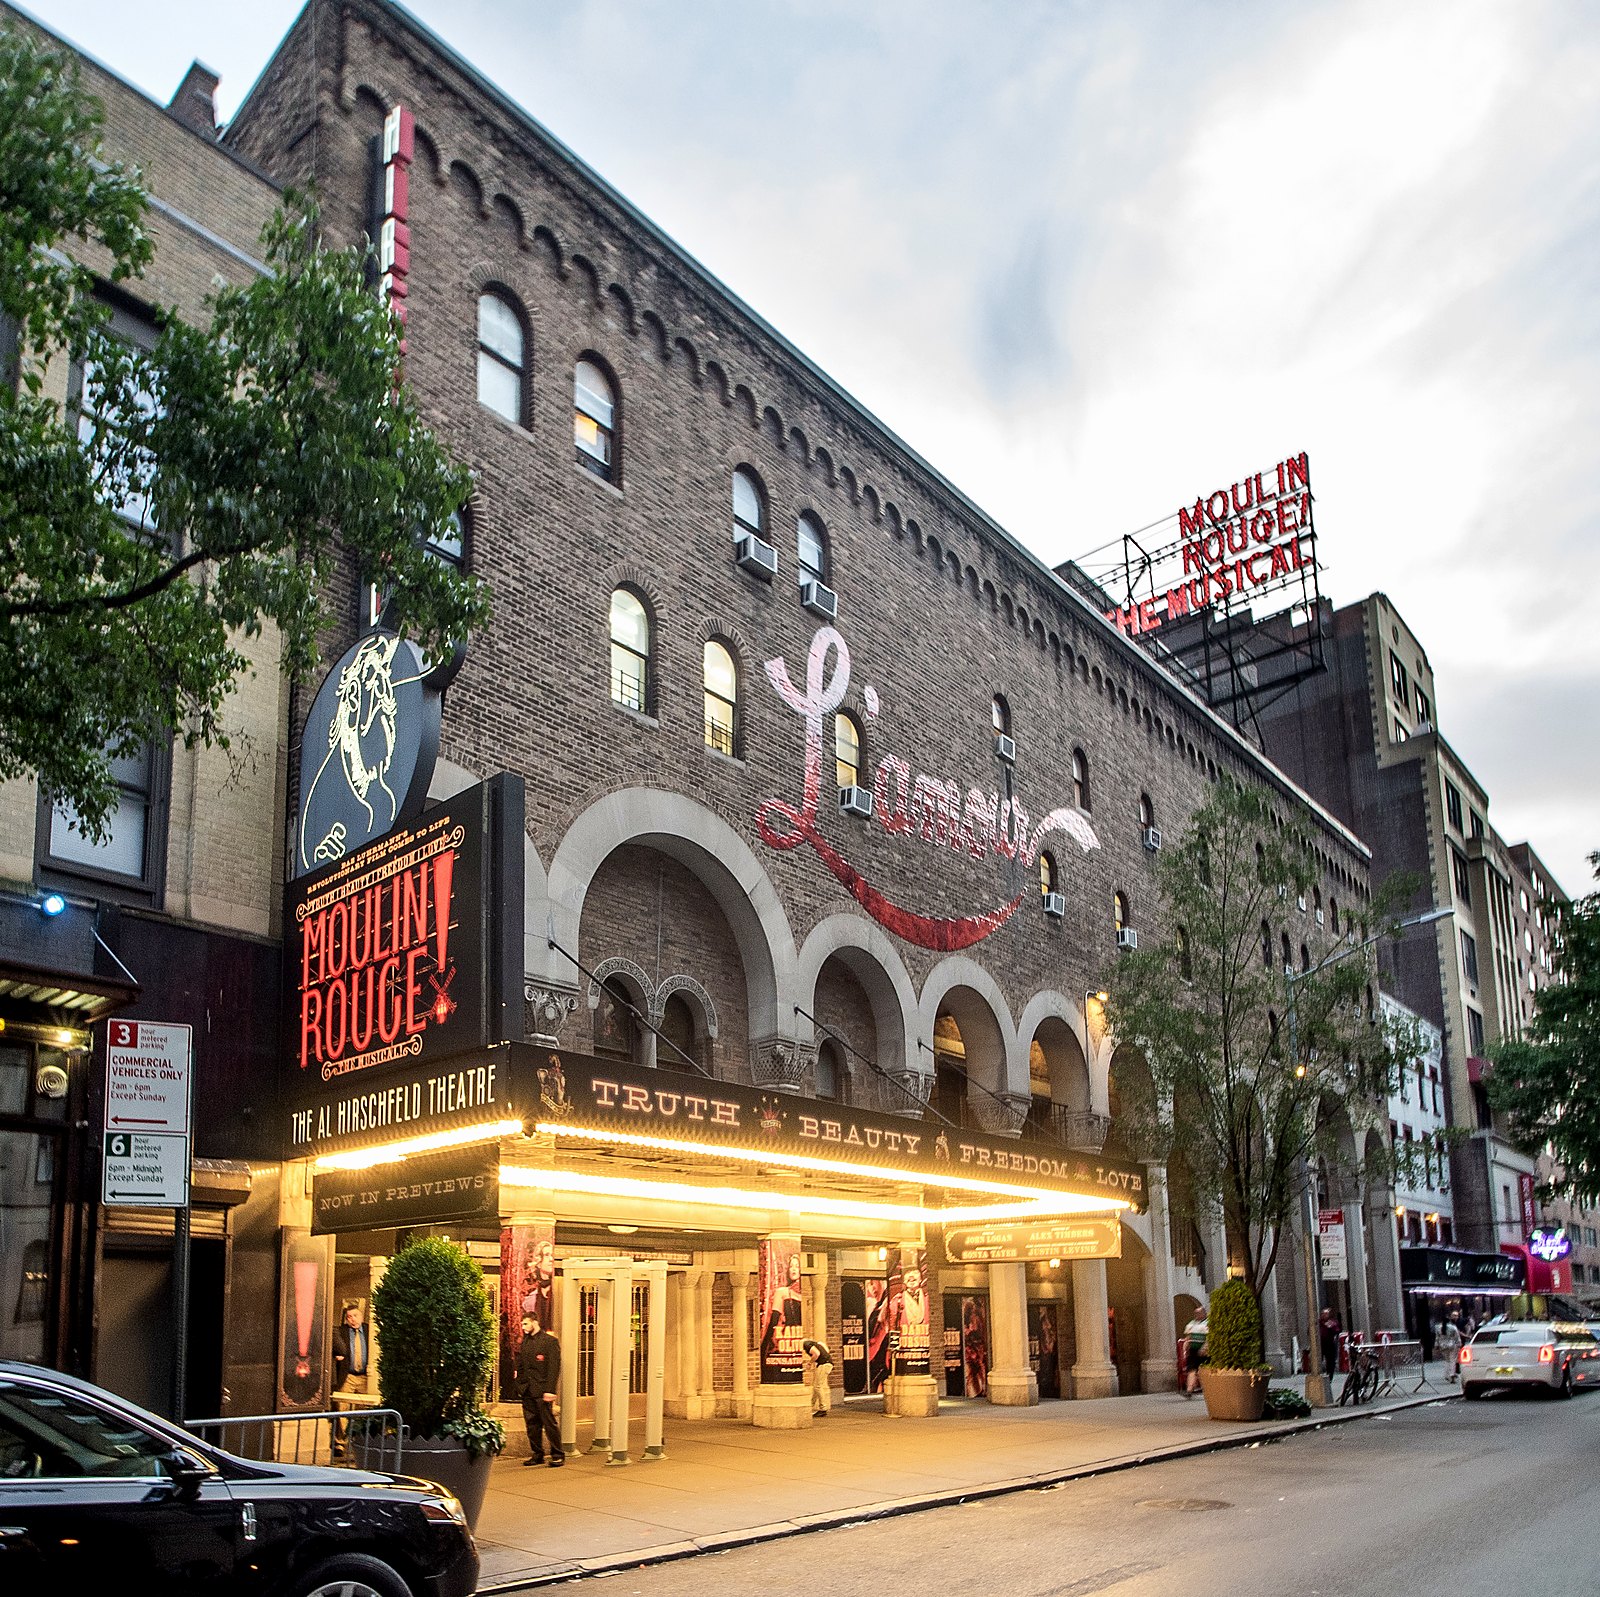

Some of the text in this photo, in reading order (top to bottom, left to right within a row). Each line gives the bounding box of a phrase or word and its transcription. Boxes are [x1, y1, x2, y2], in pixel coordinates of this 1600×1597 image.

[1178, 451, 1309, 540] MOULIN
[1167, 537, 1314, 620] MUSICAL
[307, 816, 450, 894] REVOLUTIONARY FILM COMES TO LIFE
[301, 949, 428, 1068] ROUGE
[117, 1024, 131, 1045] 3
[112, 1055, 173, 1069] COMMERCIAL
[112, 1066, 183, 1080] VEHICLES ONLY
[111, 1091, 166, 1103] Except Sunday
[112, 1081, 127, 1090] 7am
[135, 1083, 151, 1092] 6pm
[292, 1109, 313, 1145] THE
[317, 1105, 332, 1139] AL
[337, 1082, 422, 1136] HIRSCHFELD
[428, 1064, 496, 1116] THEATRE
[111, 1134, 126, 1155] 6
[591, 1079, 741, 1127] TRUTH
[798, 1115, 921, 1155] BEAUTY
[959, 1143, 1068, 1180] FREEDOM
[1096, 1167, 1143, 1191] LOVE
[107, 1173, 165, 1184] Except Sunday
[108, 1165, 125, 1173] 6pm
[133, 1164, 162, 1174] Midnight
[320, 1175, 485, 1211] NOW IN PREVIEWS
